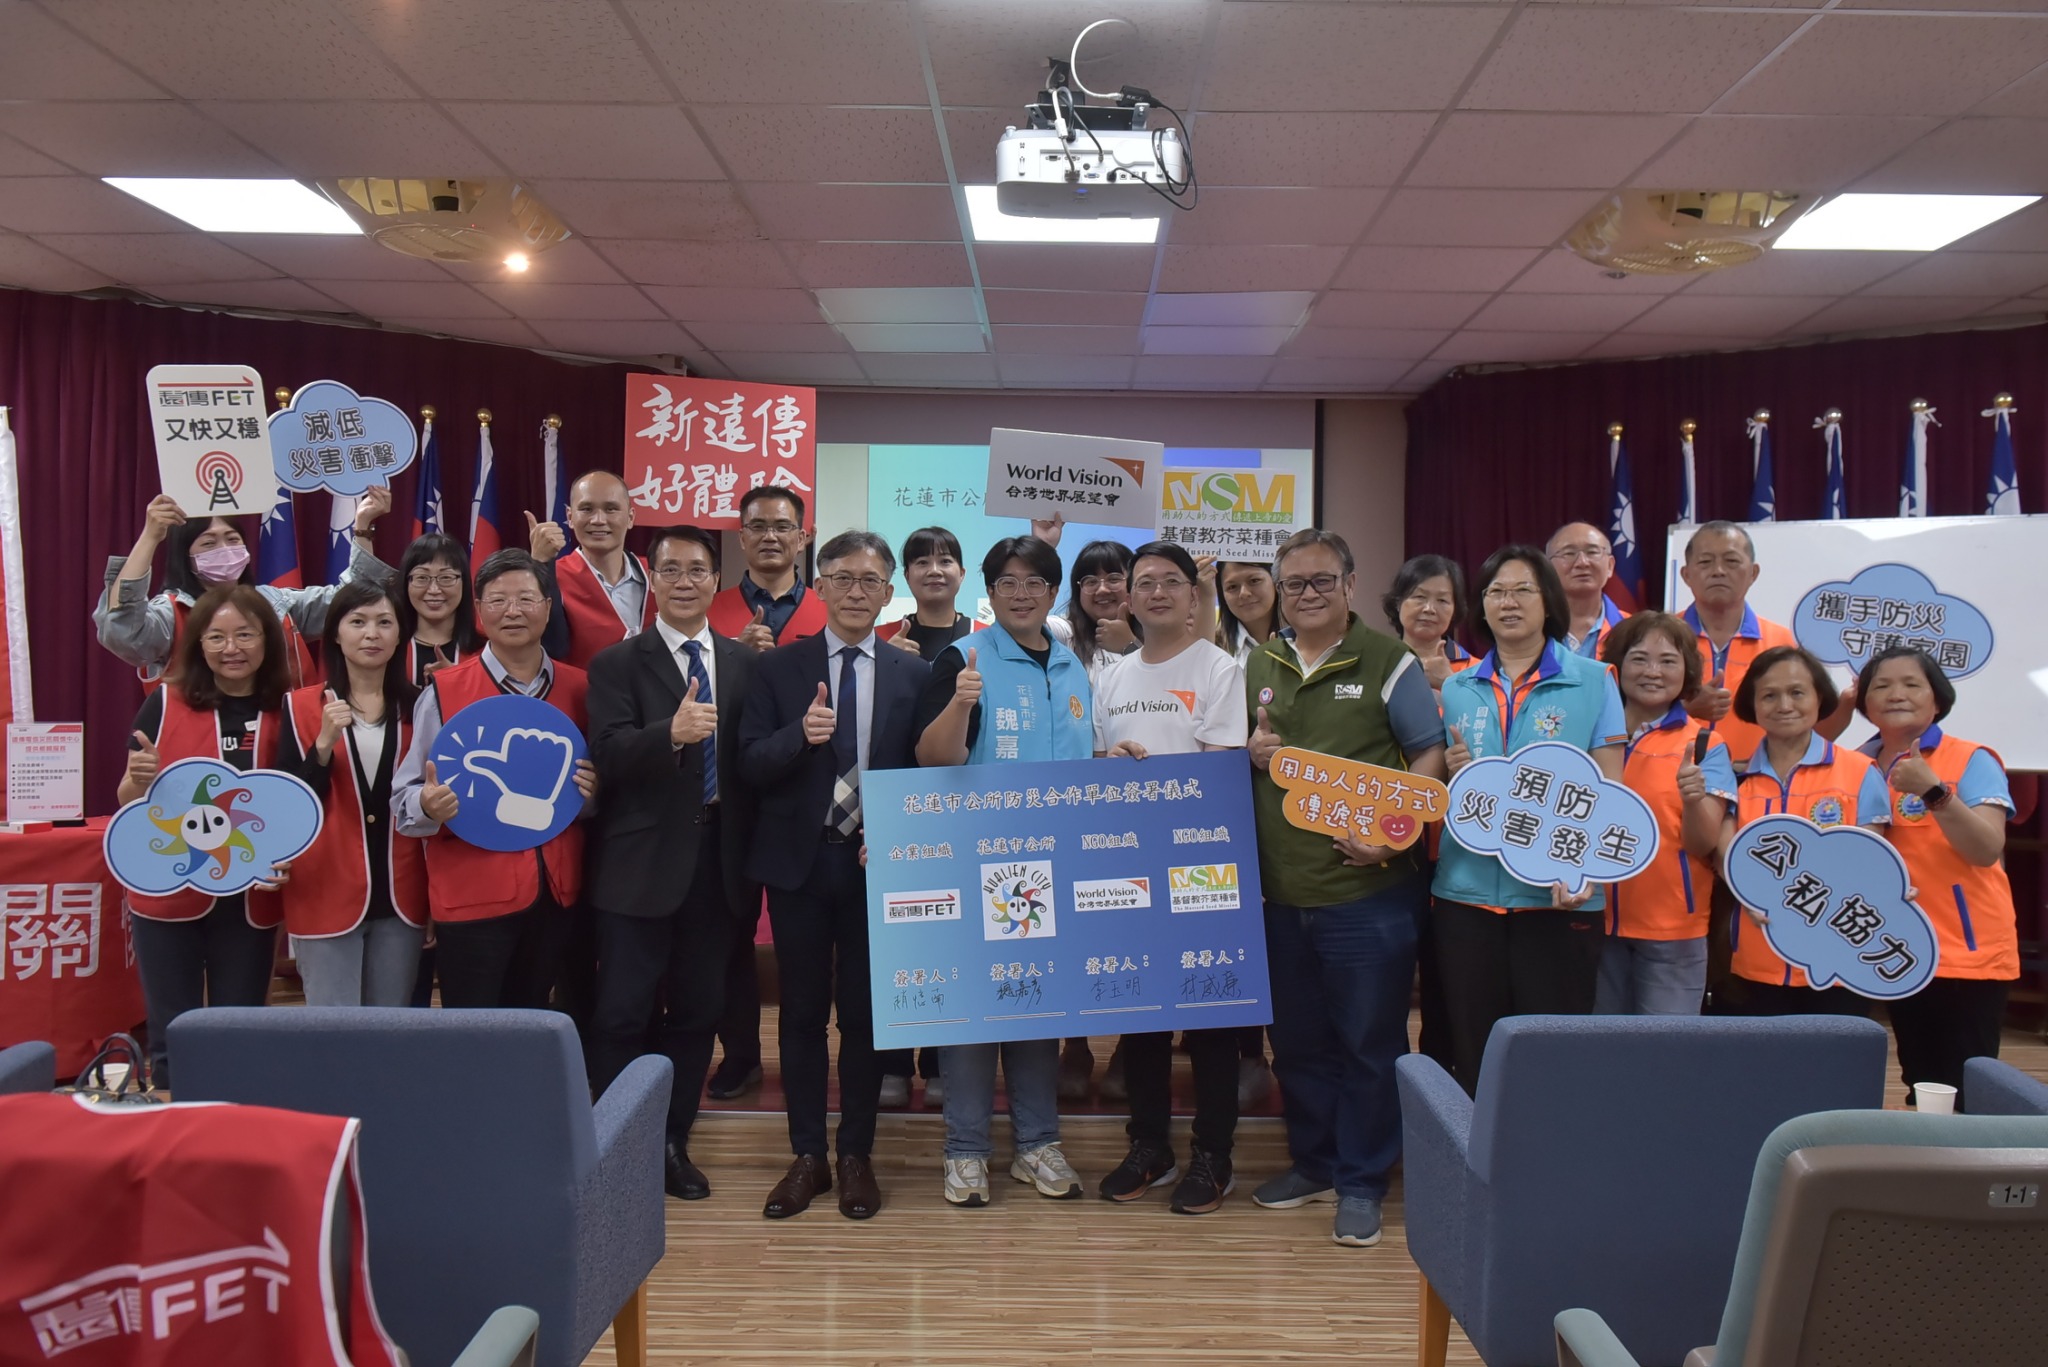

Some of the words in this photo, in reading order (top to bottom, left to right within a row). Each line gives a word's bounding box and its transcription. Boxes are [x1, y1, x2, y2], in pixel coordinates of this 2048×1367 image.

[165, 416, 261, 441] 又快又穩
[303, 409, 364, 441] 減低
[635, 383, 807, 459] 新遠傳
[1007, 463, 1062, 482] World
[1068, 468, 1122, 487] Vision
[893, 486, 986, 507] 花蓮市公
[1162, 472, 1295, 511] NSM
[1161, 526, 1292, 546] 基督教芥菜種會
[1226, 548, 1247, 557] Seed
[1252, 549, 1274, 558] Miss
[1816, 592, 1946, 634] 攜手防災
[1017, 684, 1032, 731] 花蓮市長
[1108, 700, 1138, 717] World
[1141, 700, 1178, 713] Vision
[904, 778, 1202, 814] 花蓮市公所防災合作單位簽署儀式
[1279, 757, 1439, 813] 用助人的方式
[1511, 766, 1597, 820] 預防
[1298, 794, 1376, 836] 傳遞愛
[1082, 831, 1139, 850] NGO組織
[1173, 826, 1230, 844] NGO組織
[1455, 791, 1638, 865] 災害發生
[889, 842, 953, 860] 企業組織
[977, 836, 1056, 855] 花蓮市公所
[983, 864, 1027, 895] HUALIEN
[1031, 870, 1052, 891] CITY
[1170, 864, 1237, 888] NSM
[1076, 888, 1106, 899] World
[1108, 887, 1138, 897] Vision
[1750, 834, 1916, 980] 公私協力
[2004, 1185, 2027, 1203] 1-1
